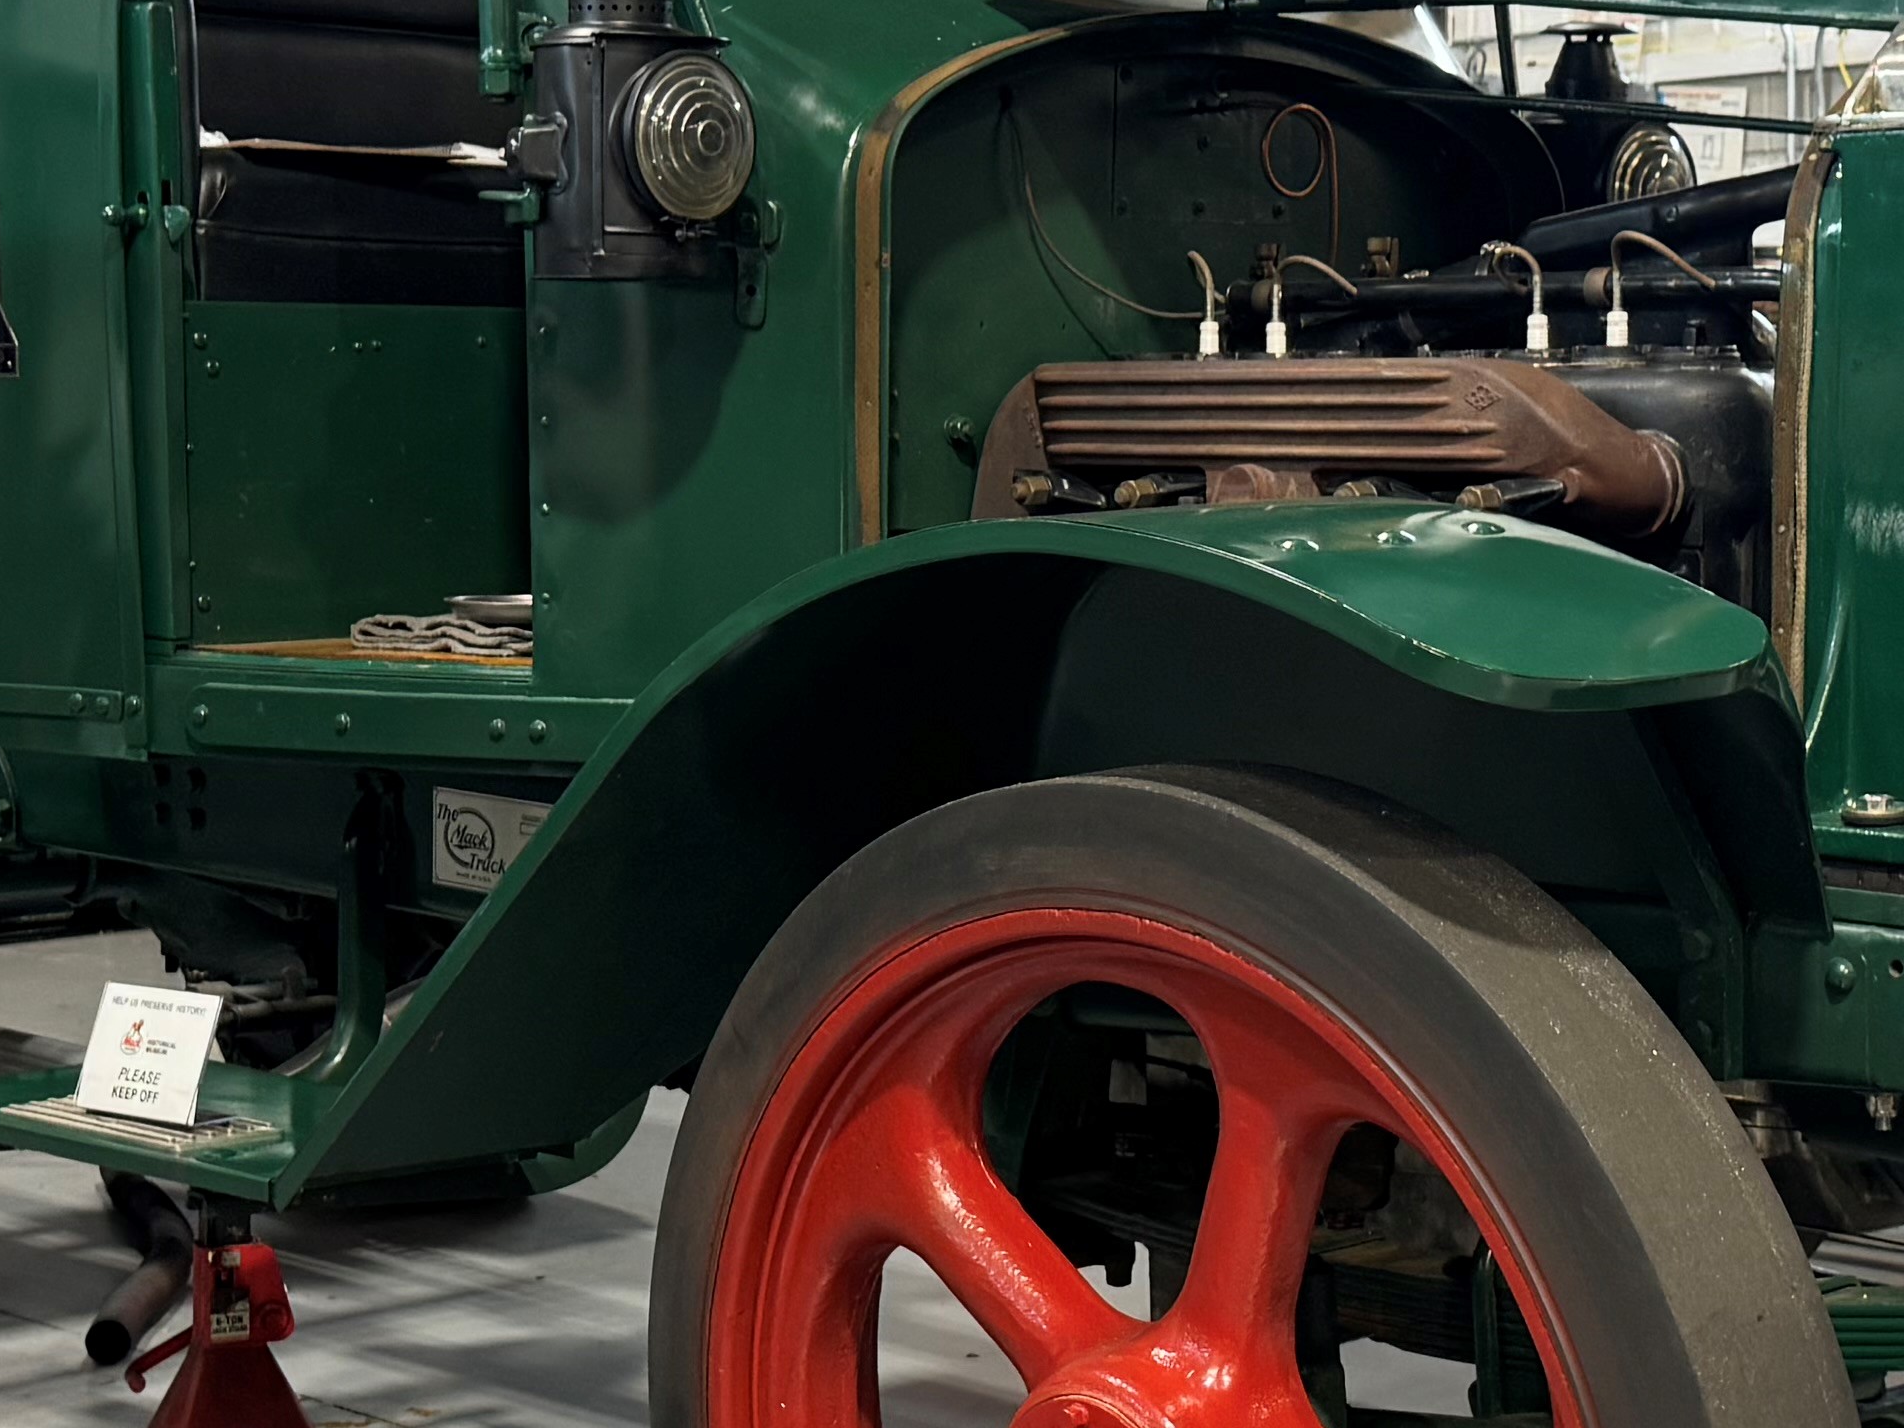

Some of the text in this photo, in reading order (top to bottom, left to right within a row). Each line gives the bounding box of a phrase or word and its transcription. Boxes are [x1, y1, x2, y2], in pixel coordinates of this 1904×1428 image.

[450, 824, 490, 851] Mack
[469, 852, 507, 874] Truck
[112, 996, 128, 1005] HELP
[130, 998, 139, 1007] US
[141, 999, 174, 1012] PRESERVE
[118, 1067, 162, 1086] PLEASE
[111, 1085, 160, 1104] KEEP OFF
